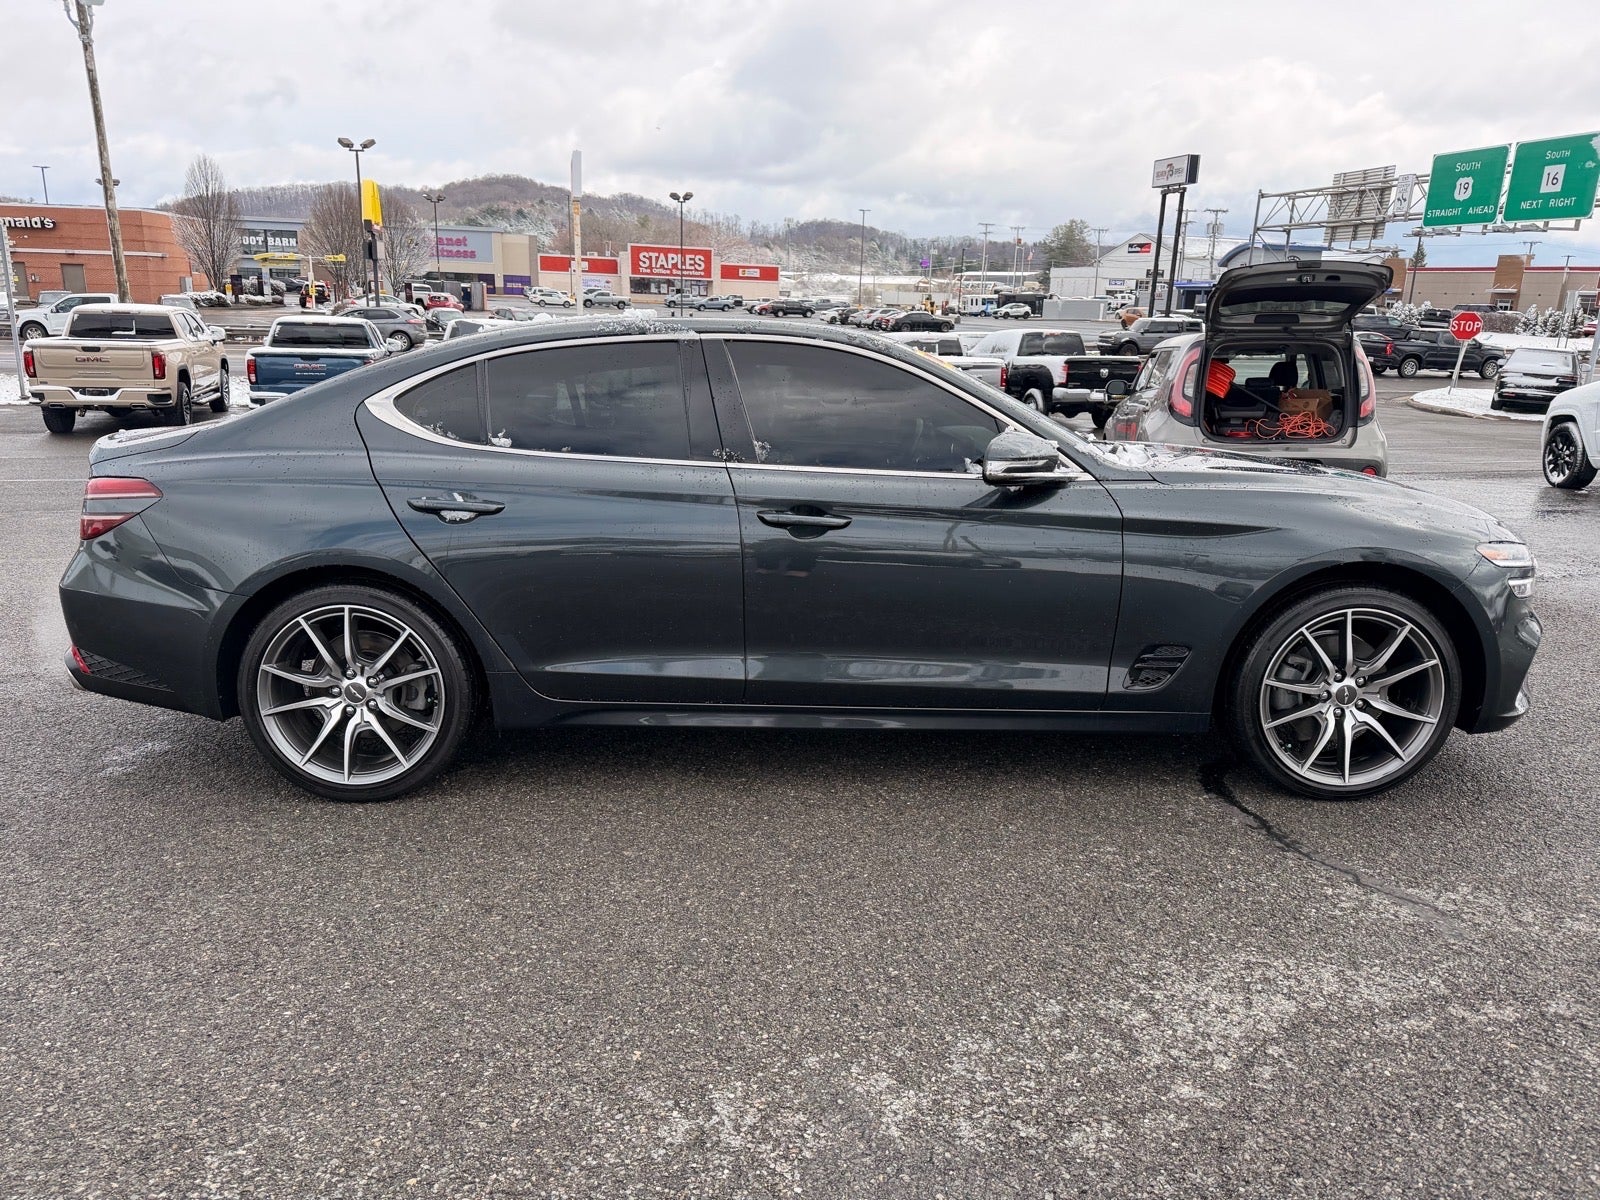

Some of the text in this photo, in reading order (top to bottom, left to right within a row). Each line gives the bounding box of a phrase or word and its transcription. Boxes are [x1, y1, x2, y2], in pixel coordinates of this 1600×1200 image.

[1545, 149, 1571, 160] SOUTH
[1455, 161, 1482, 172] SOUTH
[1545, 171, 1559, 187] 16
[1458, 181, 1470, 196] 19
[1520, 196, 1577, 209] NEXT RIGHT
[1426, 205, 1495, 218] STRAIGHT AHEAD
[236, 236, 297, 247] OOT BARN
[638, 251, 706, 271] STAPLES
[1451, 320, 1481, 332] STOP
[75, 355, 111, 363] GMC
